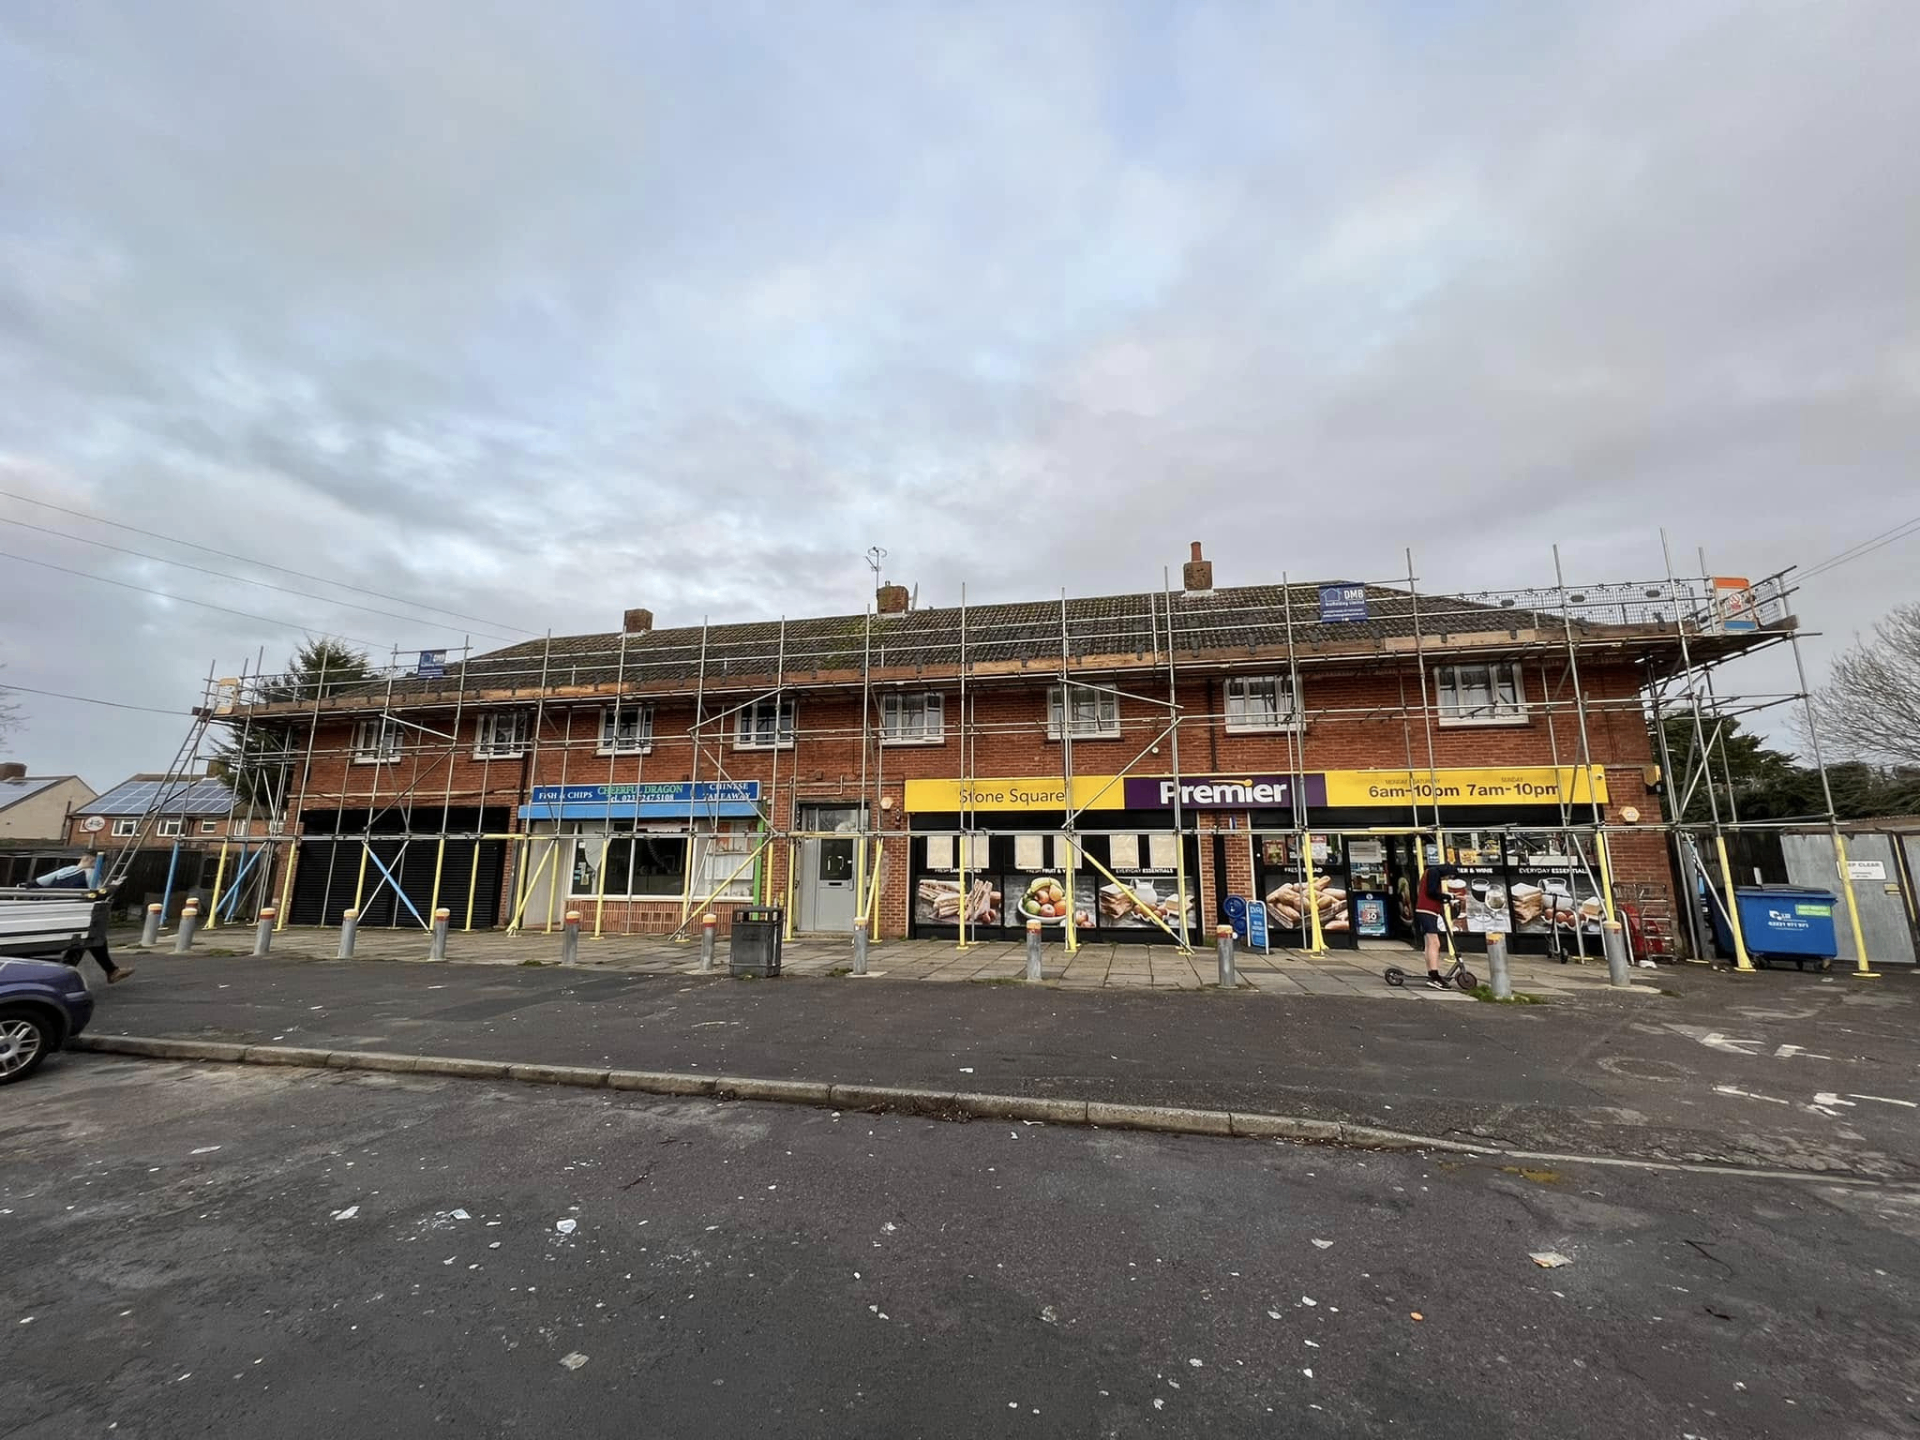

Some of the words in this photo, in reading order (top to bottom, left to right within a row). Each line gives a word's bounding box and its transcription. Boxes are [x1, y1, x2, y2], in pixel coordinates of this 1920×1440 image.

[1343, 588, 1364, 600] DMB
[644, 784, 683, 794] DRAGON
[1159, 779, 1288, 804] Premier
[539, 792, 557, 800] FISH
[567, 791, 593, 799] CHIPS
[959, 788, 1004, 803] Stone
[1009, 788, 1065, 806] Square
